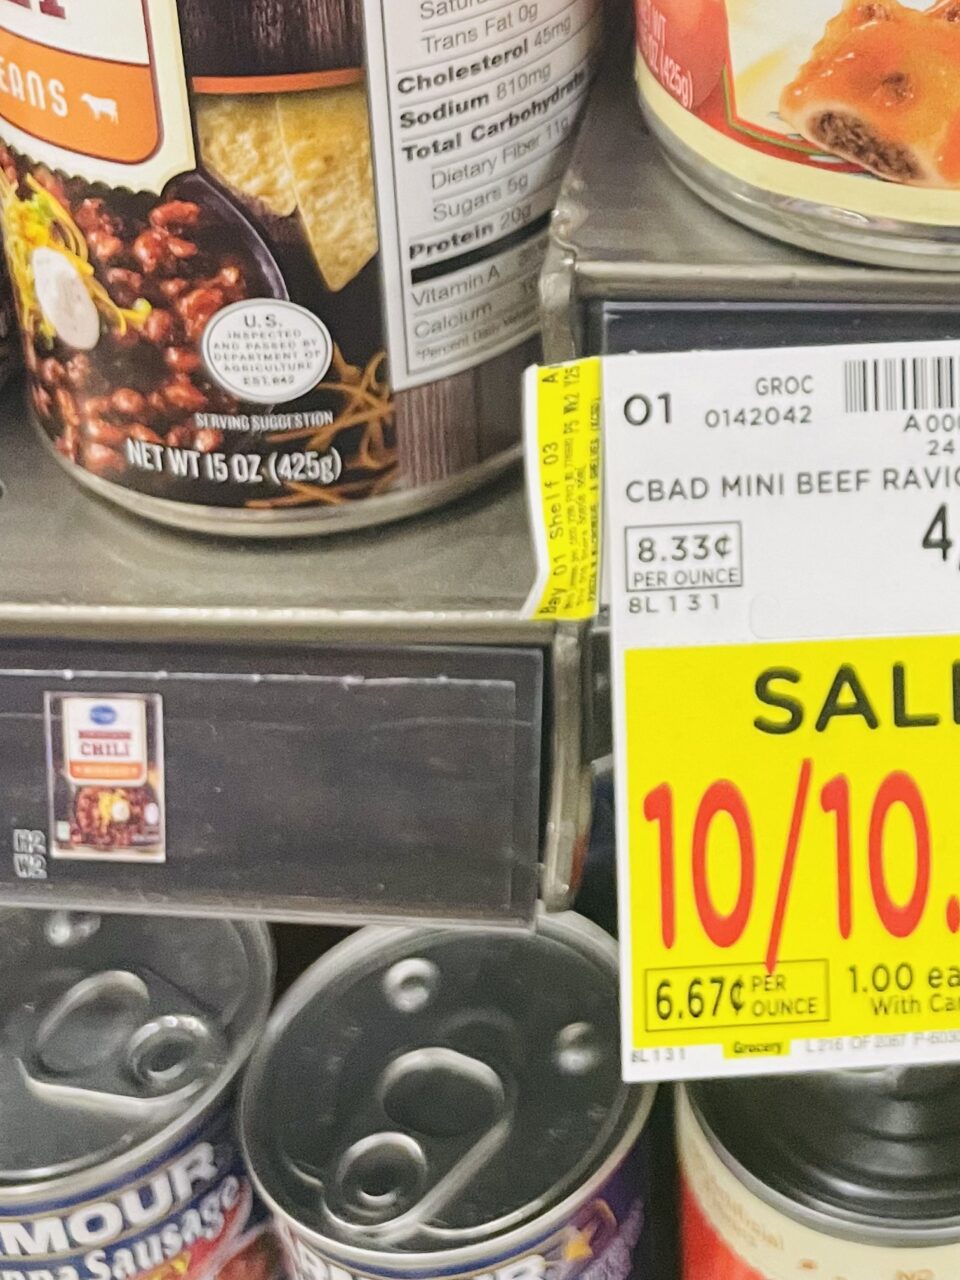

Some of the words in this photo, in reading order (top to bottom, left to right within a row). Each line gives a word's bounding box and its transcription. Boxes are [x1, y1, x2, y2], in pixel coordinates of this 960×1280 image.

[421, 28, 479, 55] Trans
[485, 13, 513, 37] Fat
[518, 2, 538, 23] 0g
[397, 38, 528, 95] Cholesterol
[534, 15, 572, 48] 45mg
[399, 93, 490, 129] Sodium
[402, 132, 462, 163] Total
[431, 155, 498, 191] Dietary
[502, 134, 541, 165] Fiber
[433, 188, 502, 222] Sugars
[409, 222, 494, 260] Protein
[410, 273, 484, 308] Vitamin
[487, 265, 500, 283] A
[414, 301, 493, 339] Calcium
[755, 375, 815, 397] GROC
[195, 412, 249, 431] SERVING
[250, 411, 334, 431] SUGGESTION
[623, 391, 674, 427] 01
[704, 404, 814, 429] 0142042
[126, 437, 164, 472] NET
[166, 447, 200, 478] WT
[205, 453, 228, 482] 15
[230, 454, 262, 483] OZ
[267, 446, 342, 486] (425g)
[542, 441, 559, 466] 03
[926, 439, 957, 457] 24
[625, 476, 709, 503] CBAD
[720, 472, 786, 498] MINI
[797, 469, 871, 495] BEEF
[544, 480, 564, 540] Shelf
[637, 532, 734, 564] 8.33¢
[633, 569, 668, 587] PER
[673, 565, 740, 585] OUNCE
[848, 963, 914, 994] 1.00
[655, 975, 746, 1021] 6.67¢
[751, 975, 787, 994] PER
[751, 997, 818, 1017] OUNCE
[871, 995, 922, 1017] With
[733, 1040, 783, 1055] Grocery
